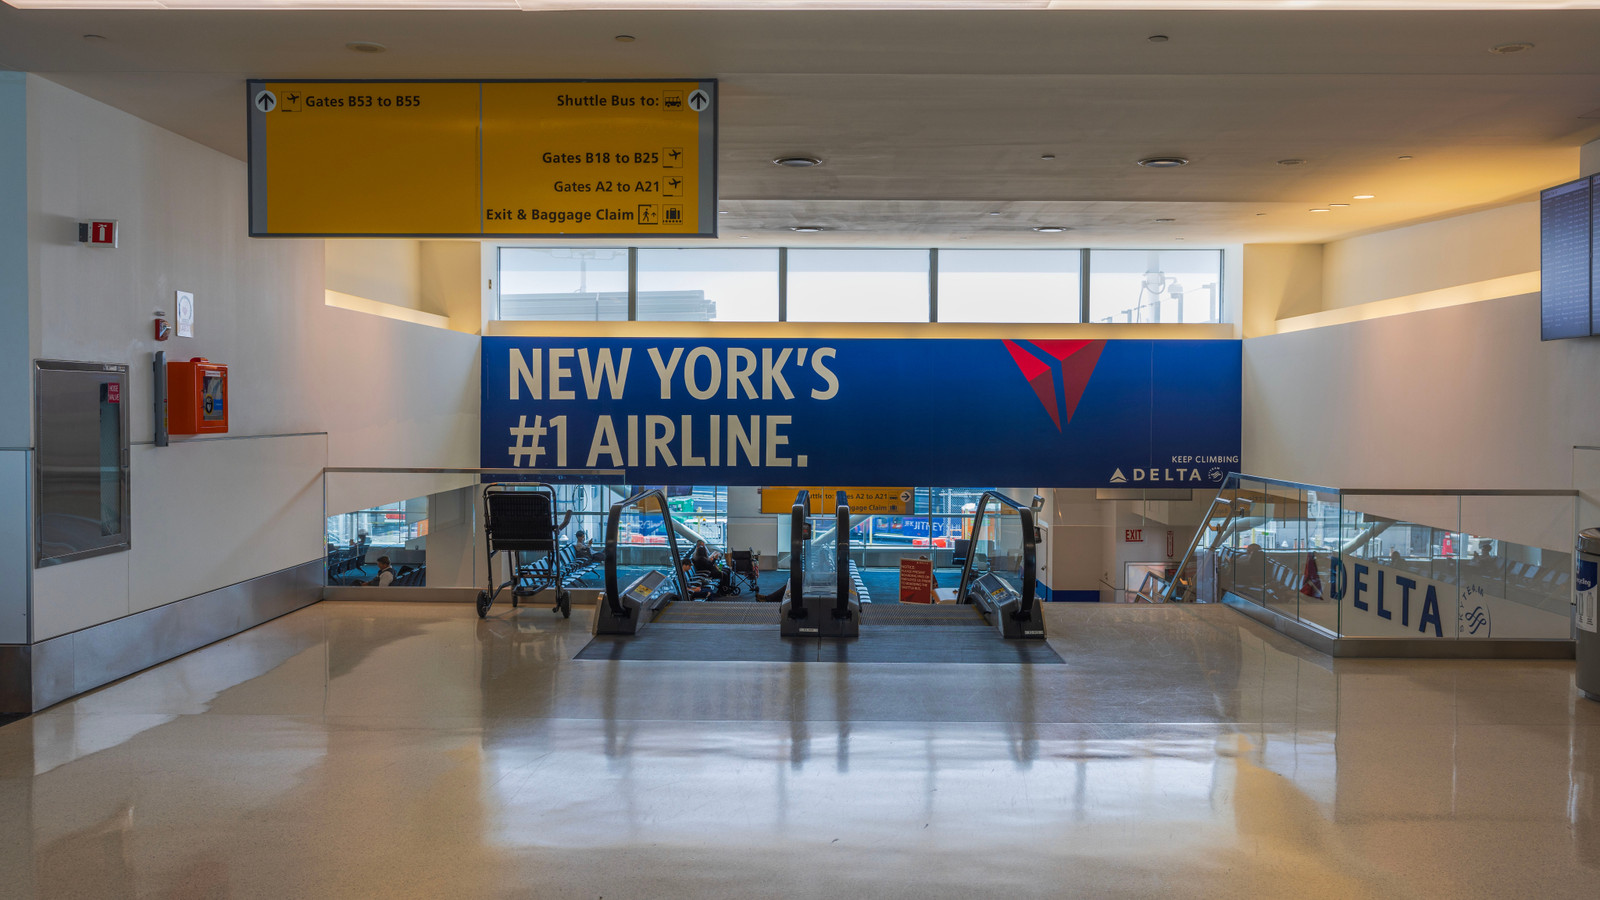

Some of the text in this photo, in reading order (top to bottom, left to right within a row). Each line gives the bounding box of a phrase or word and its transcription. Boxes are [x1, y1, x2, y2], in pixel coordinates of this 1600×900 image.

[305, 95, 421, 108] Gates B53 to B55
[557, 94, 659, 107] Shuttle Bus to:
[542, 151, 659, 164] Gates B18 to B25
[553, 180, 659, 193] Gates A2 to A21
[486, 208, 634, 223] Exit & Baggage Claim
[508, 346, 840, 400] NEW YORK'S
[508, 414, 808, 467] #1 AIRLINE.
[1171, 455, 1239, 463] KEEP CLIMBING
[1133, 468, 1202, 481] DELTA
[1125, 529, 1142, 540] EXIT
[1329, 555, 1443, 637] DELTA
